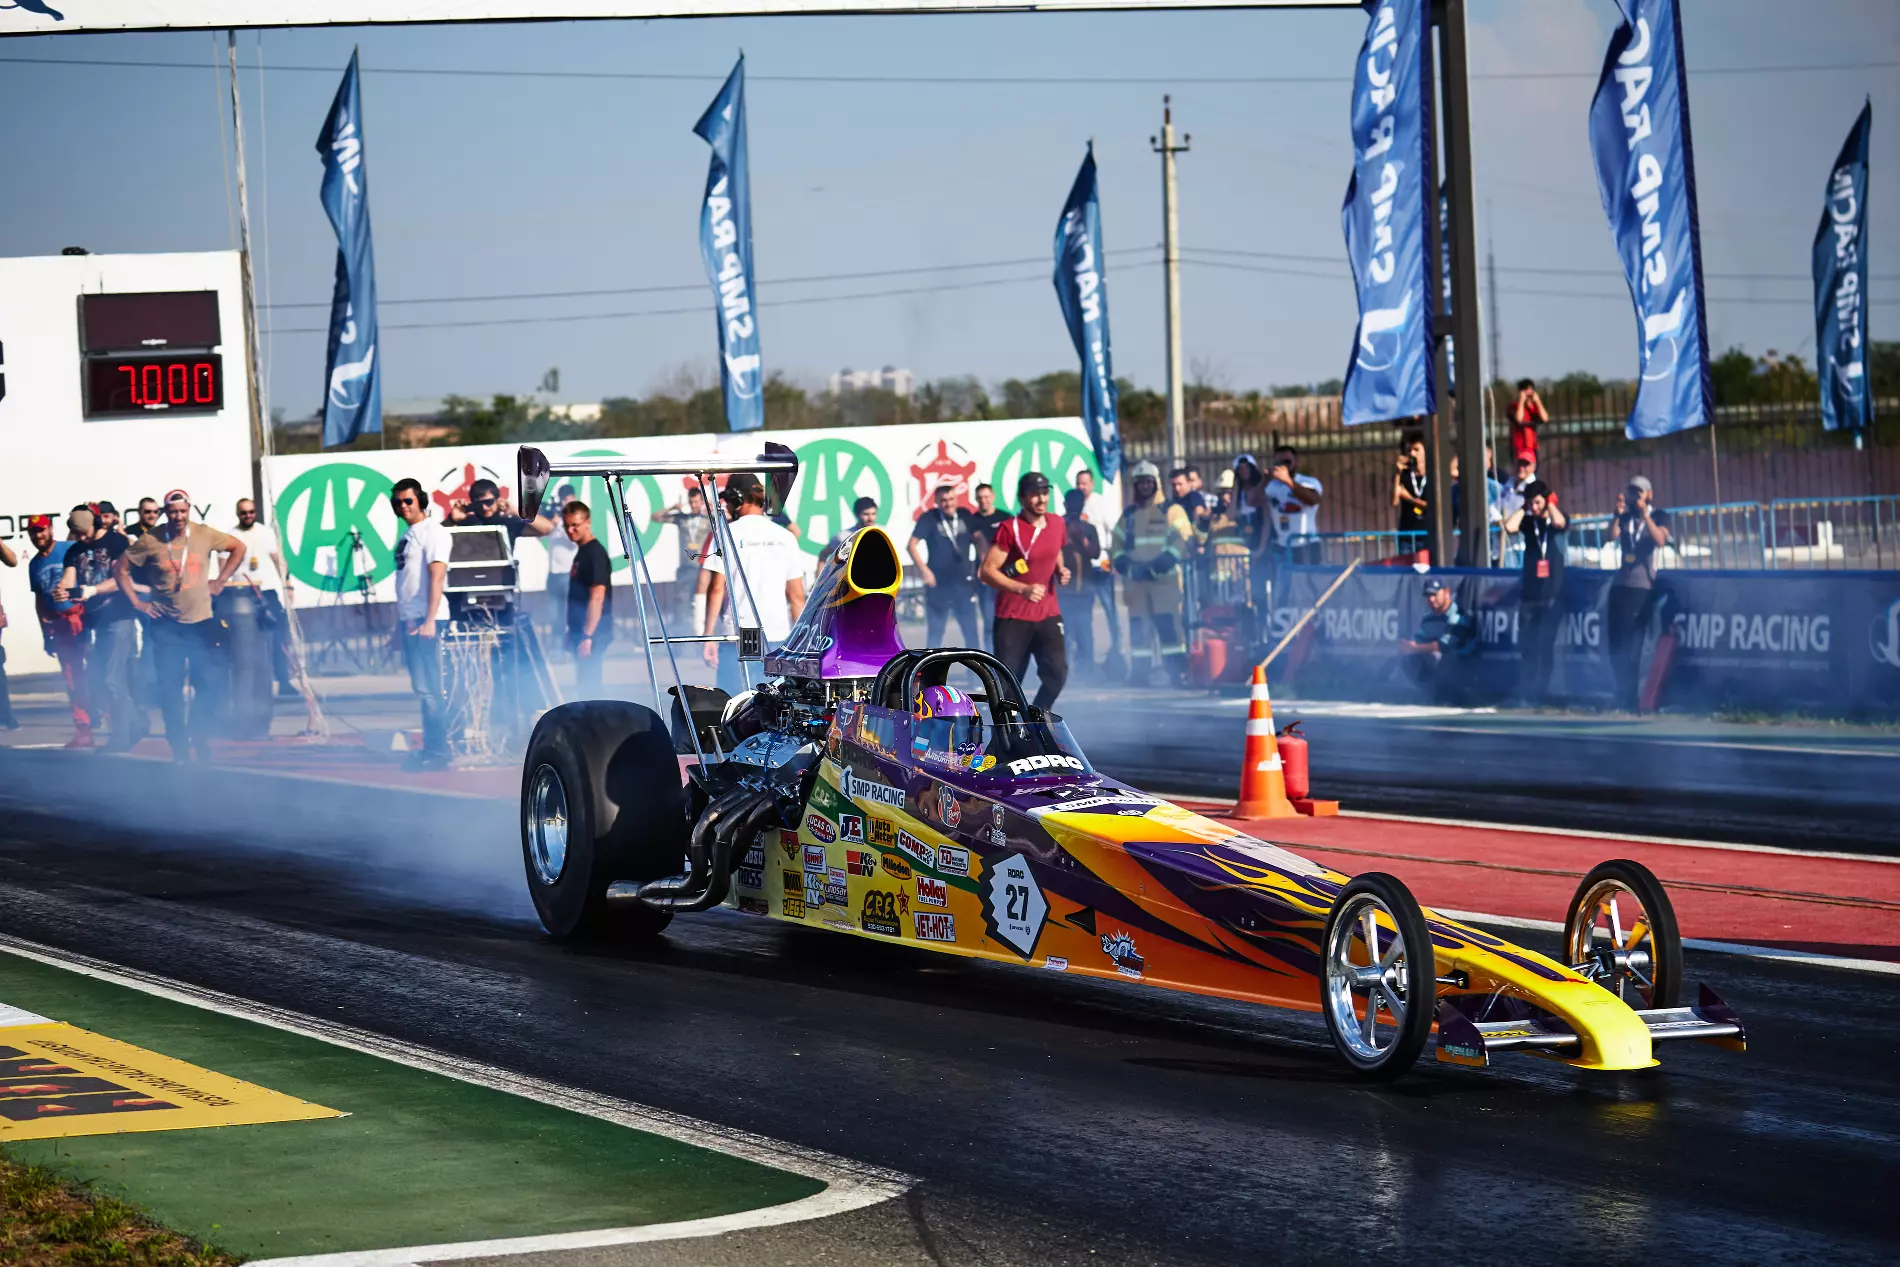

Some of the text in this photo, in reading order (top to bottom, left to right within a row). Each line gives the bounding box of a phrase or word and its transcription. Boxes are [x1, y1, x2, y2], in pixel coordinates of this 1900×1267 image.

[118, 363, 214, 405] 7.000
[1324, 608, 1398, 641] RACING
[1674, 613, 1829, 652] SMP RACING
[852, 779, 905, 807] SMP RACING
[806, 814, 826, 831] LUCAS
[875, 819, 891, 832] Auto
[899, 832, 926, 857] COMP
[917, 877, 946, 906] Holley
[1006, 883, 1029, 921] 27
[916, 914, 949, 940] JET-HOT
